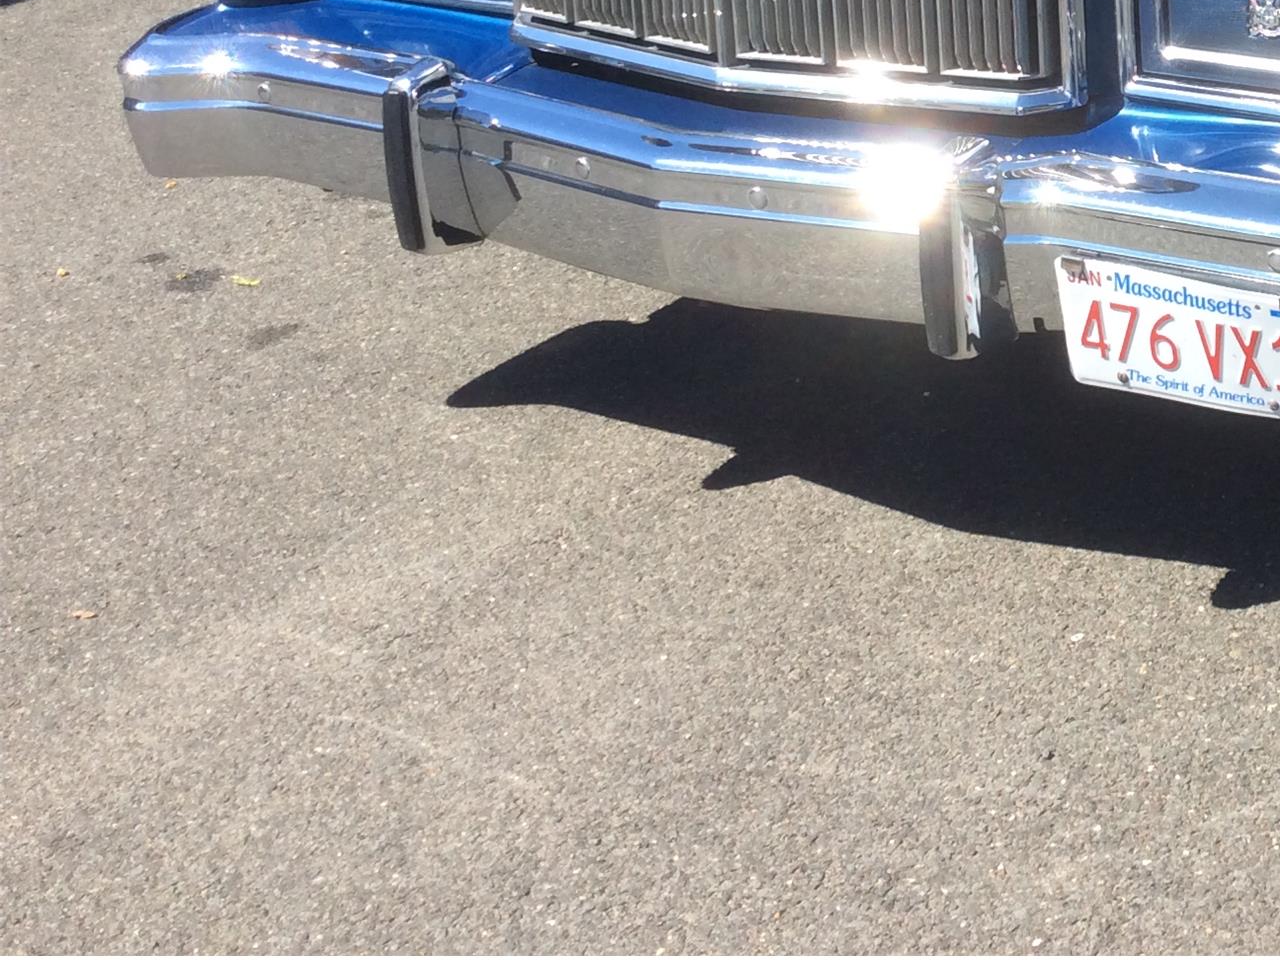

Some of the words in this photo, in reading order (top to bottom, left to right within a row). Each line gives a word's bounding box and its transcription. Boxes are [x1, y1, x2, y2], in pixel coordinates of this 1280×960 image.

[1067, 269, 1102, 287] JAN
[1114, 271, 1252, 320] Massachusetts
[1080, 299, 1182, 372] 476
[1126, 368, 1151, 385] The
[1155, 374, 1190, 392] Spirit
[1193, 384, 1207, 397] of
[1209, 386, 1266, 406] America
